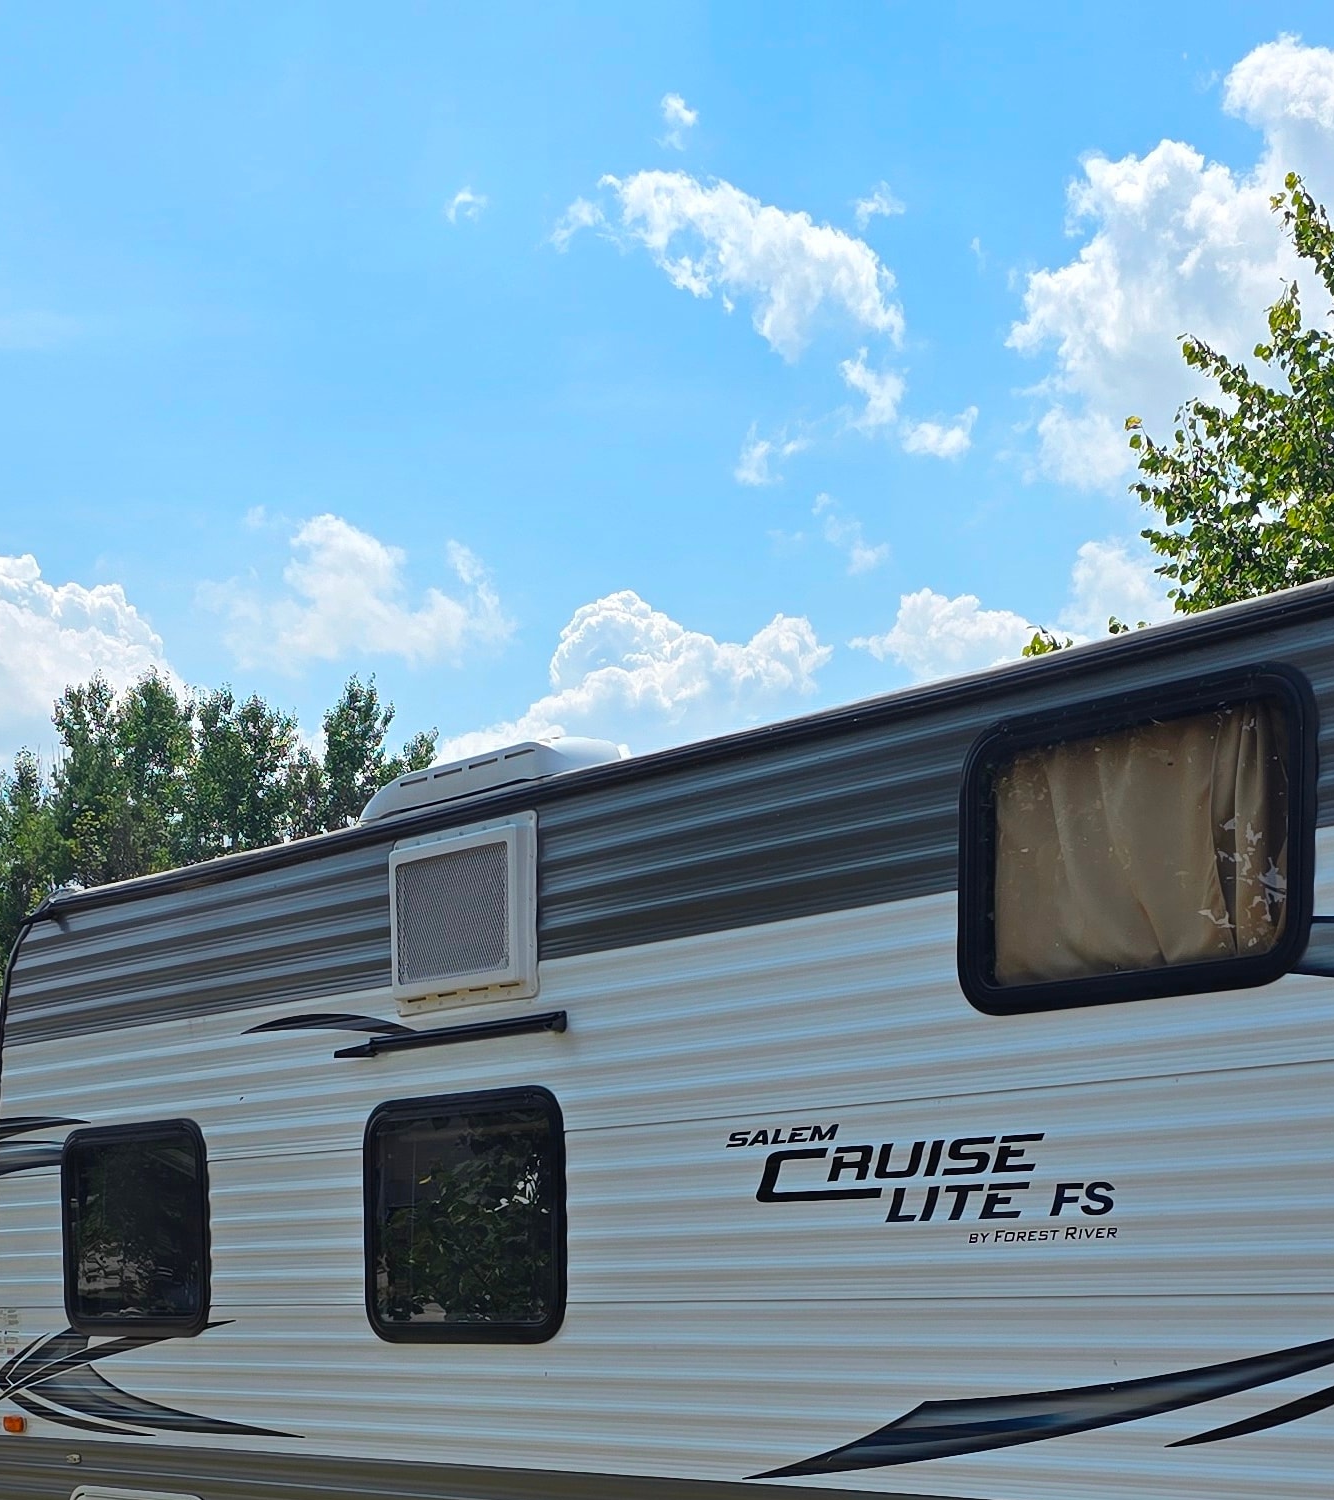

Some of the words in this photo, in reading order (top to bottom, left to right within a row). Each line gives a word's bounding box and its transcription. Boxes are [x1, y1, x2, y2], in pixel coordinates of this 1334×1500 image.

[725, 1123, 840, 1148] SALEM
[755, 1132, 1045, 1203] CRUISE
[884, 1181, 1031, 1223] LITE
[1049, 1181, 1116, 1217] FS
[968, 1232, 990, 1244] BY
[994, 1230, 1060, 1243] FOREST
[1064, 1226, 1118, 1240] RIVER
